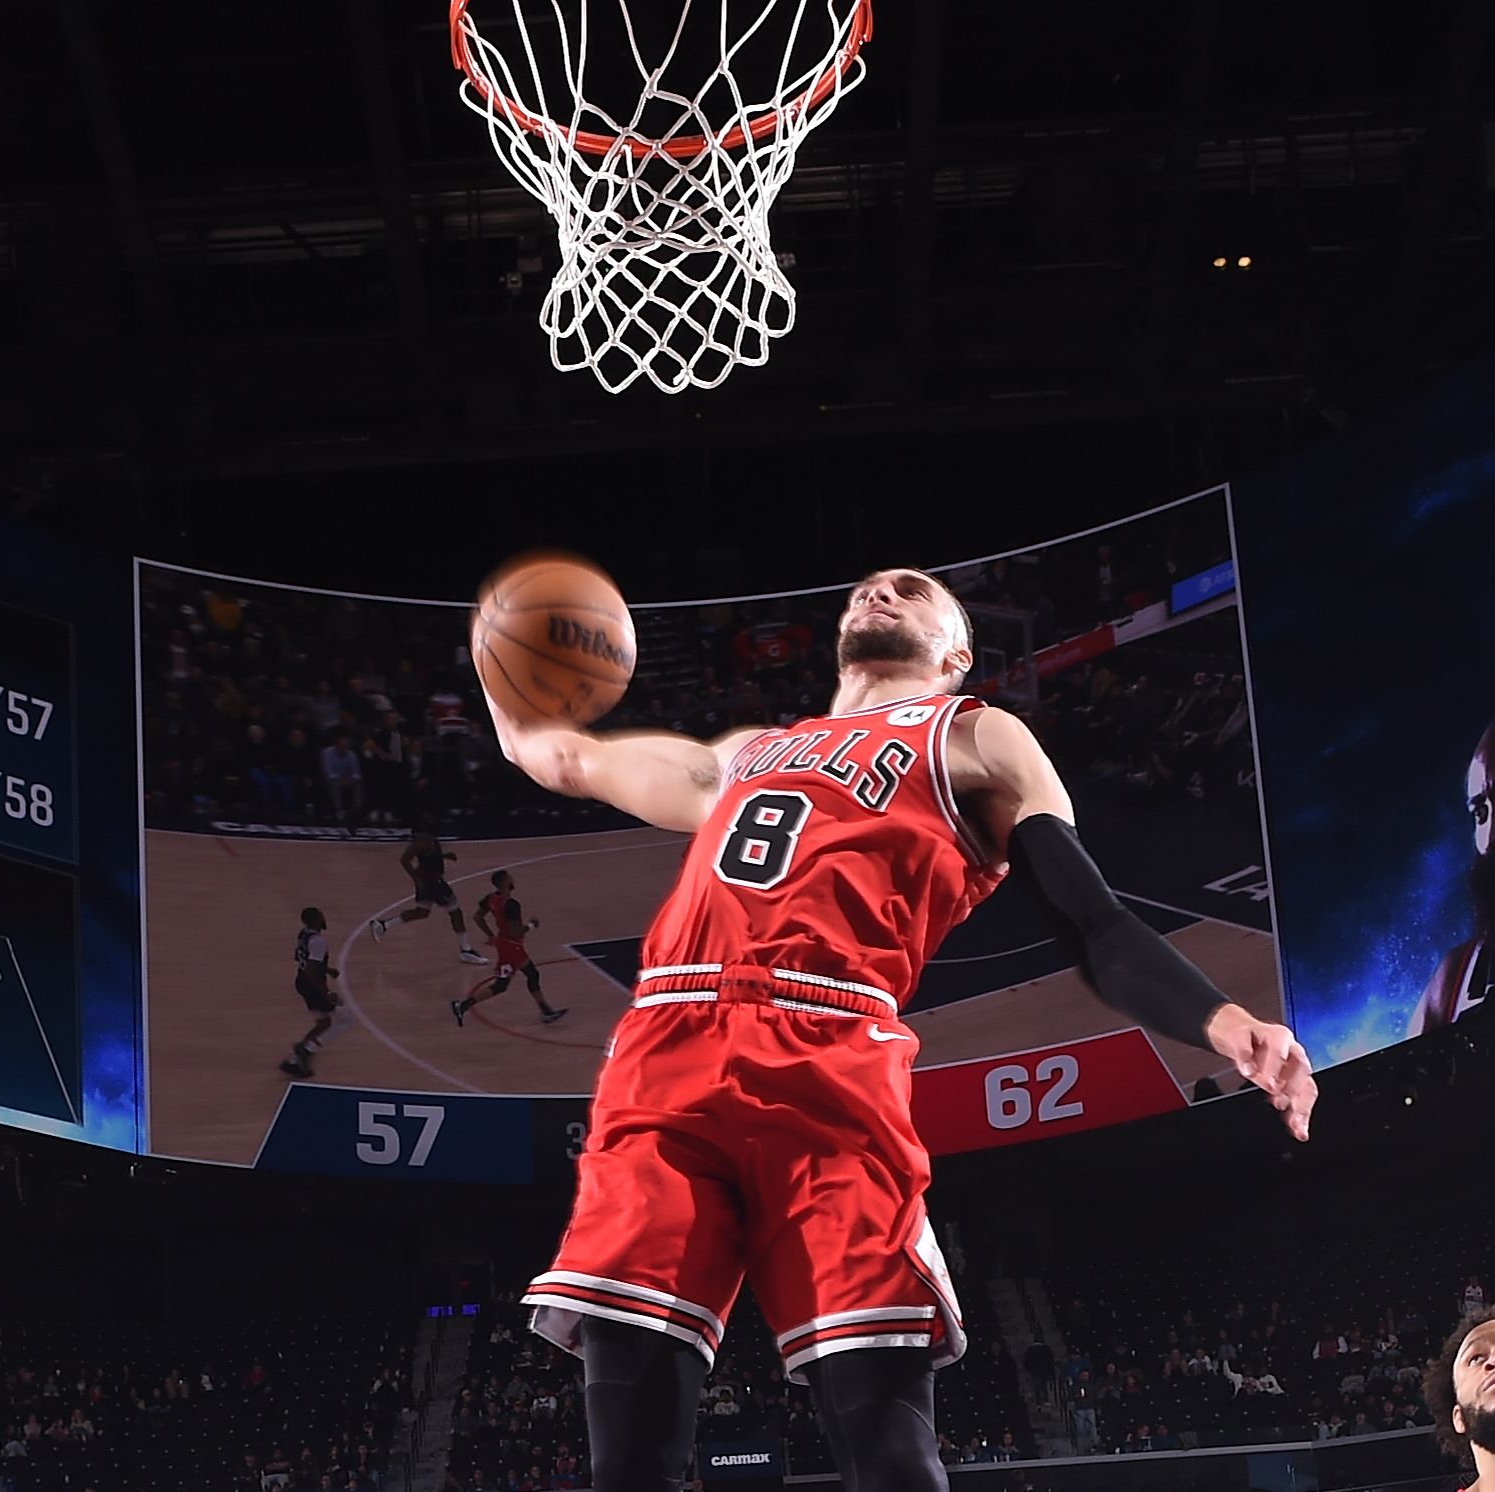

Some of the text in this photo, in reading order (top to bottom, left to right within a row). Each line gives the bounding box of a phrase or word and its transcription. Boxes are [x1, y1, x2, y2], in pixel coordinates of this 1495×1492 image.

[714, 789, 814, 890] 8
[984, 1054, 1084, 1131] 62
[355, 1101, 445, 1167] 57
